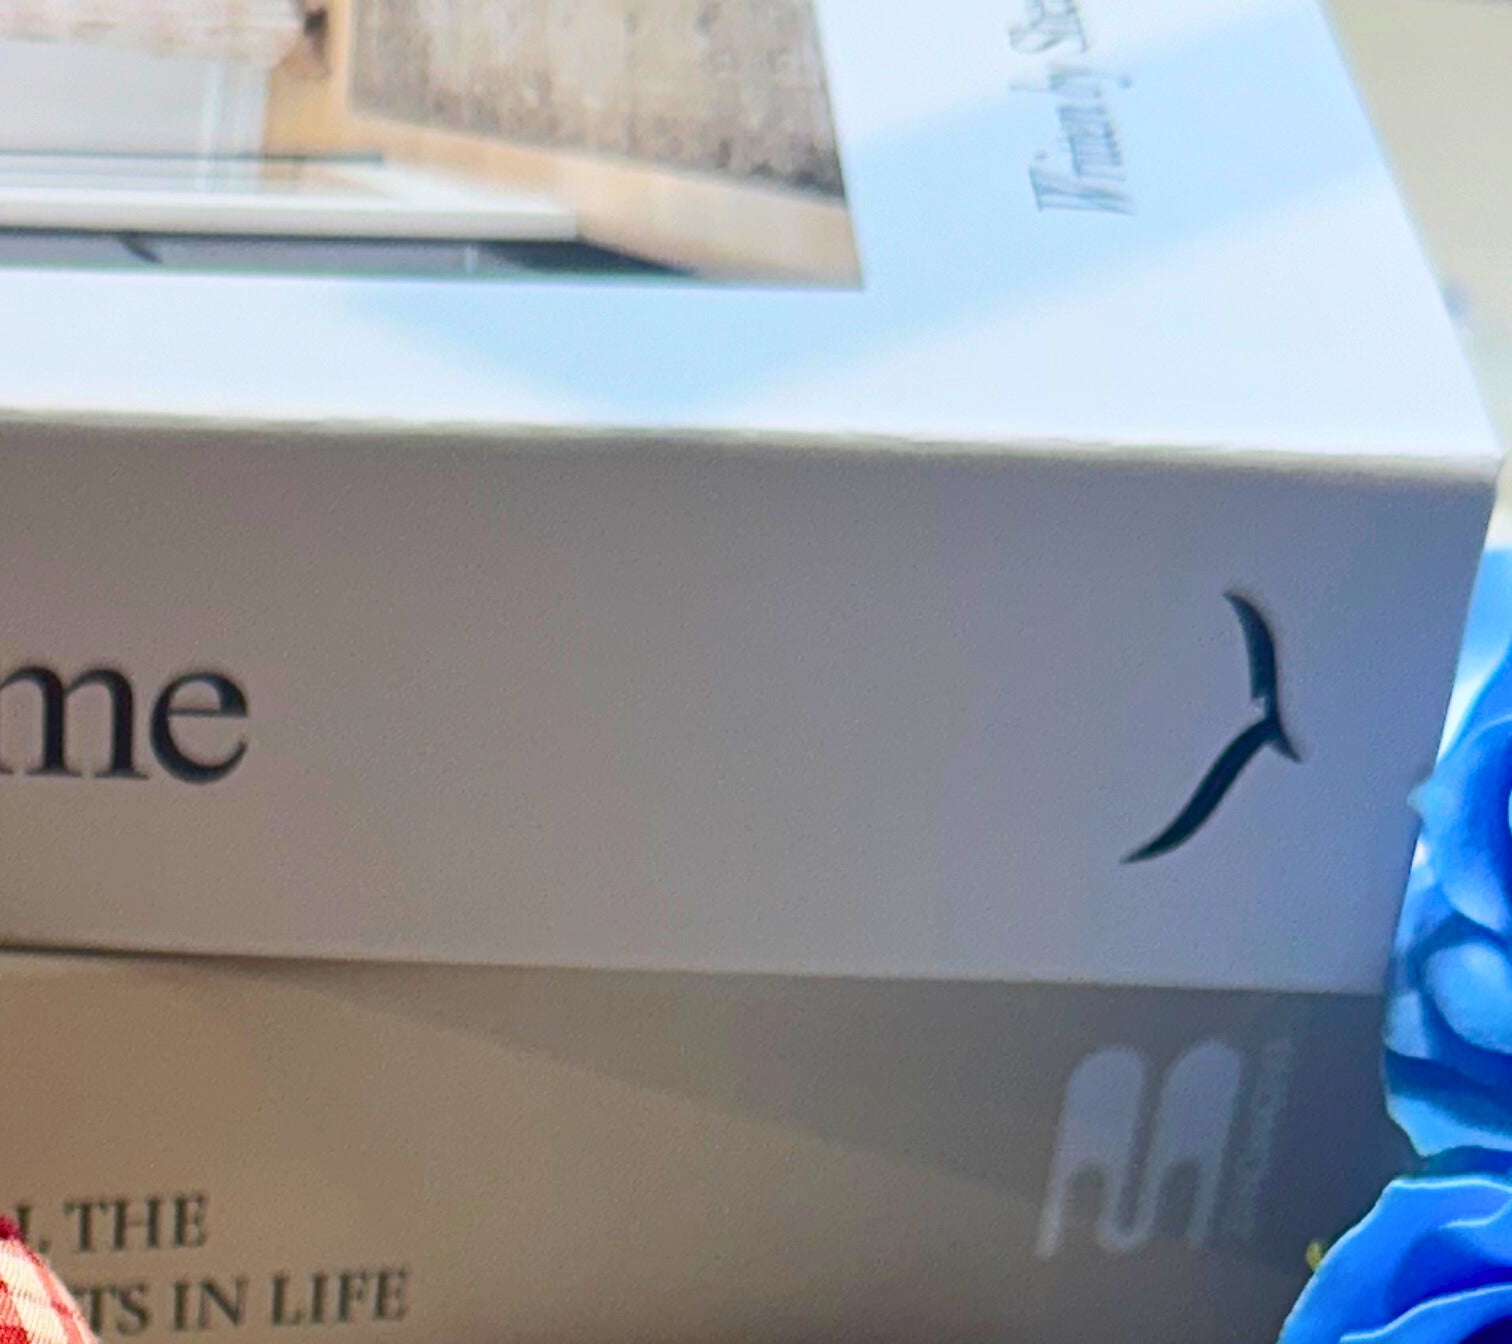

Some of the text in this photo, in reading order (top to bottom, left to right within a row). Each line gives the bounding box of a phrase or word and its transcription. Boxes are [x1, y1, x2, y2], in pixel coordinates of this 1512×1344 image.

[63, 1192, 209, 1254] THE
[173, 1272, 249, 1334] IN
[270, 1262, 410, 1328] LIFE
